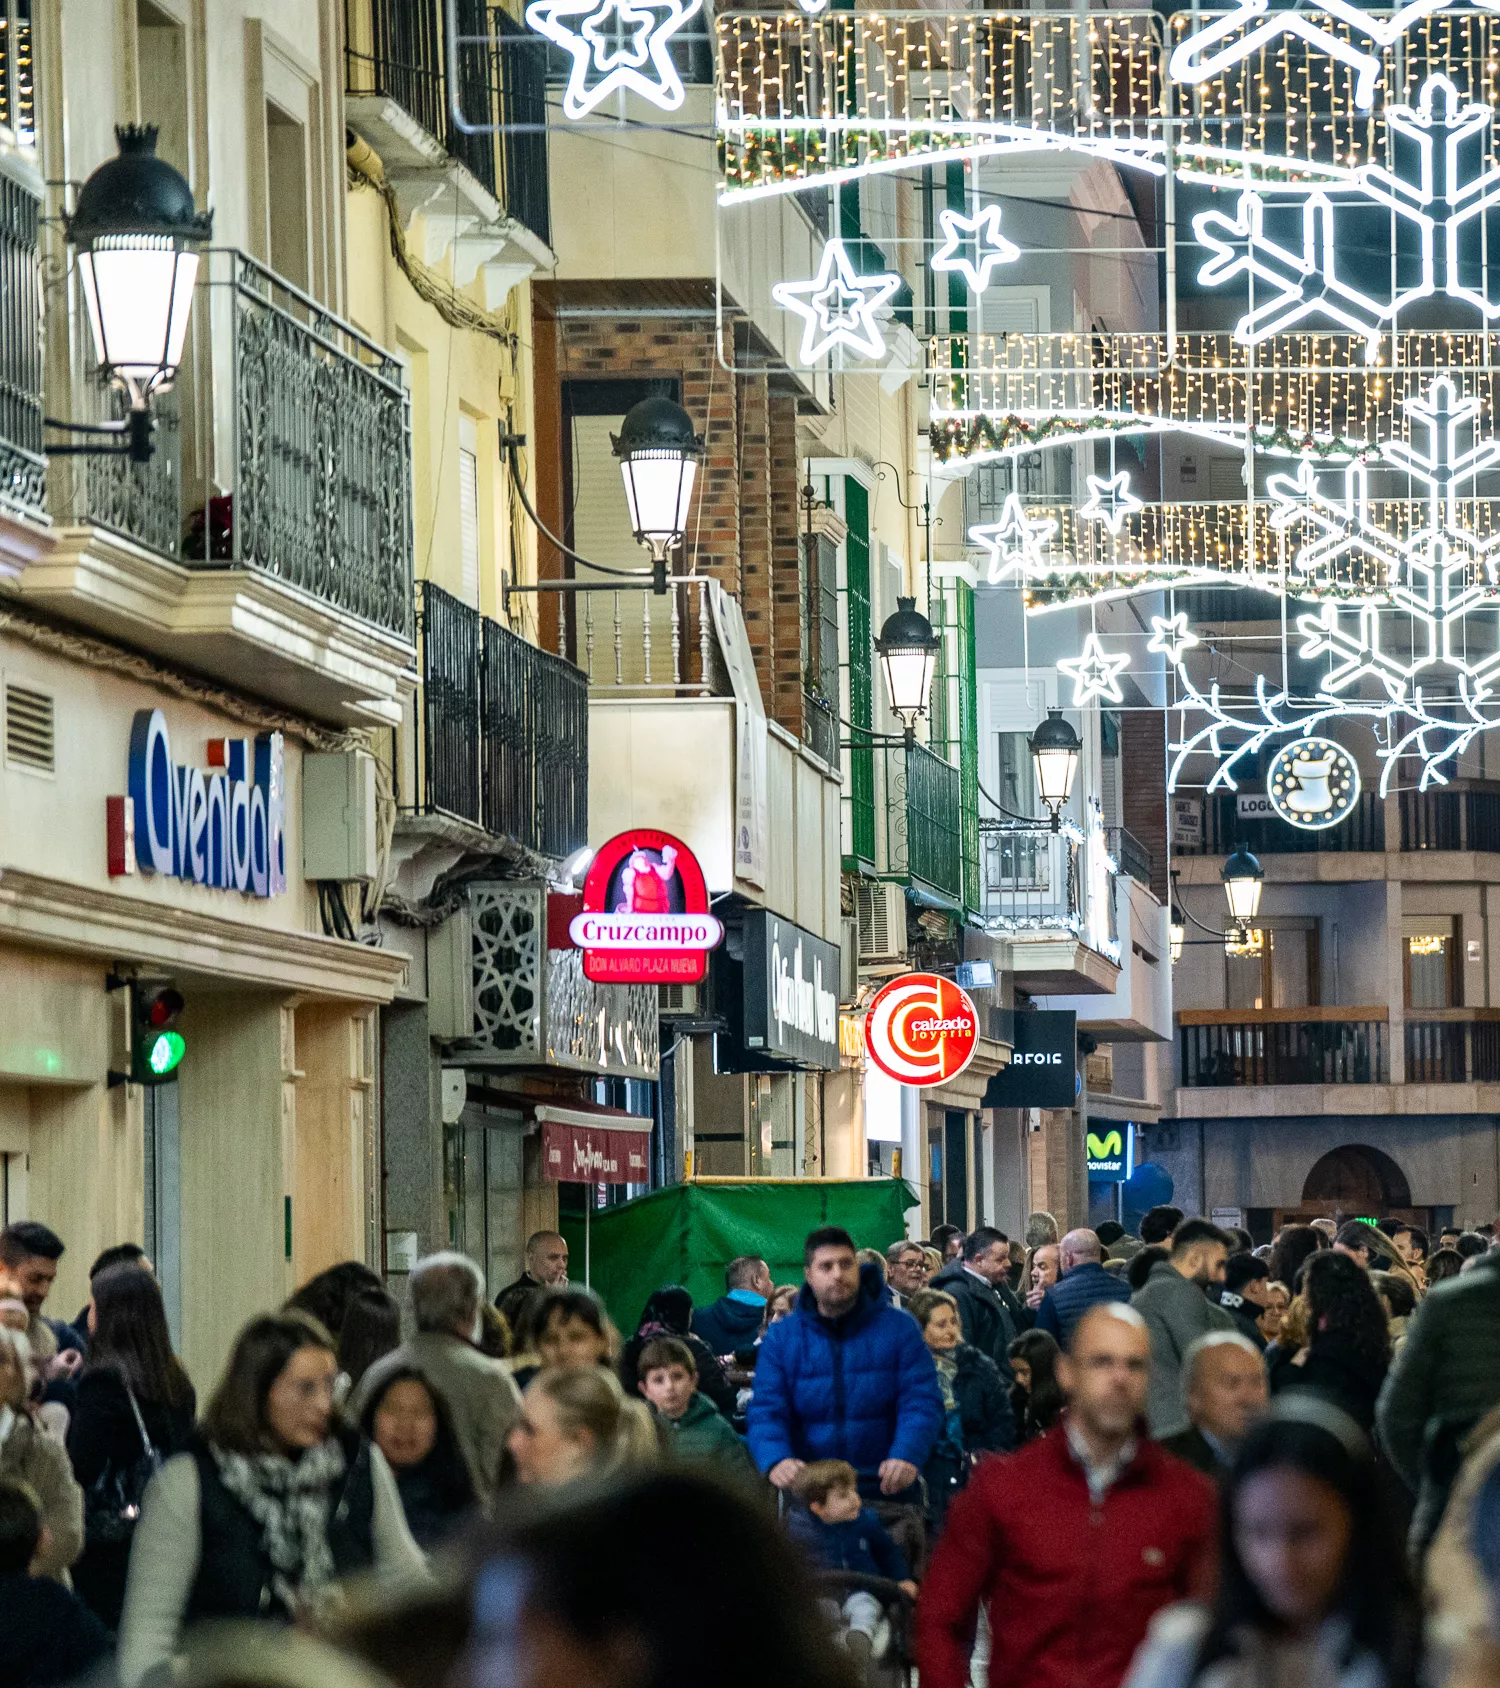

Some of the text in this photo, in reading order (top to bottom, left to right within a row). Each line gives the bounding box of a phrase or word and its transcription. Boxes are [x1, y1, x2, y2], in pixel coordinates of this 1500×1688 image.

[582, 920, 707, 945] Cruzcampo
[589, 955, 607, 973] DON
[643, 957, 669, 973] PLAZA
[670, 957, 698, 973] NUEVA
[911, 1015, 972, 1031] calzado
